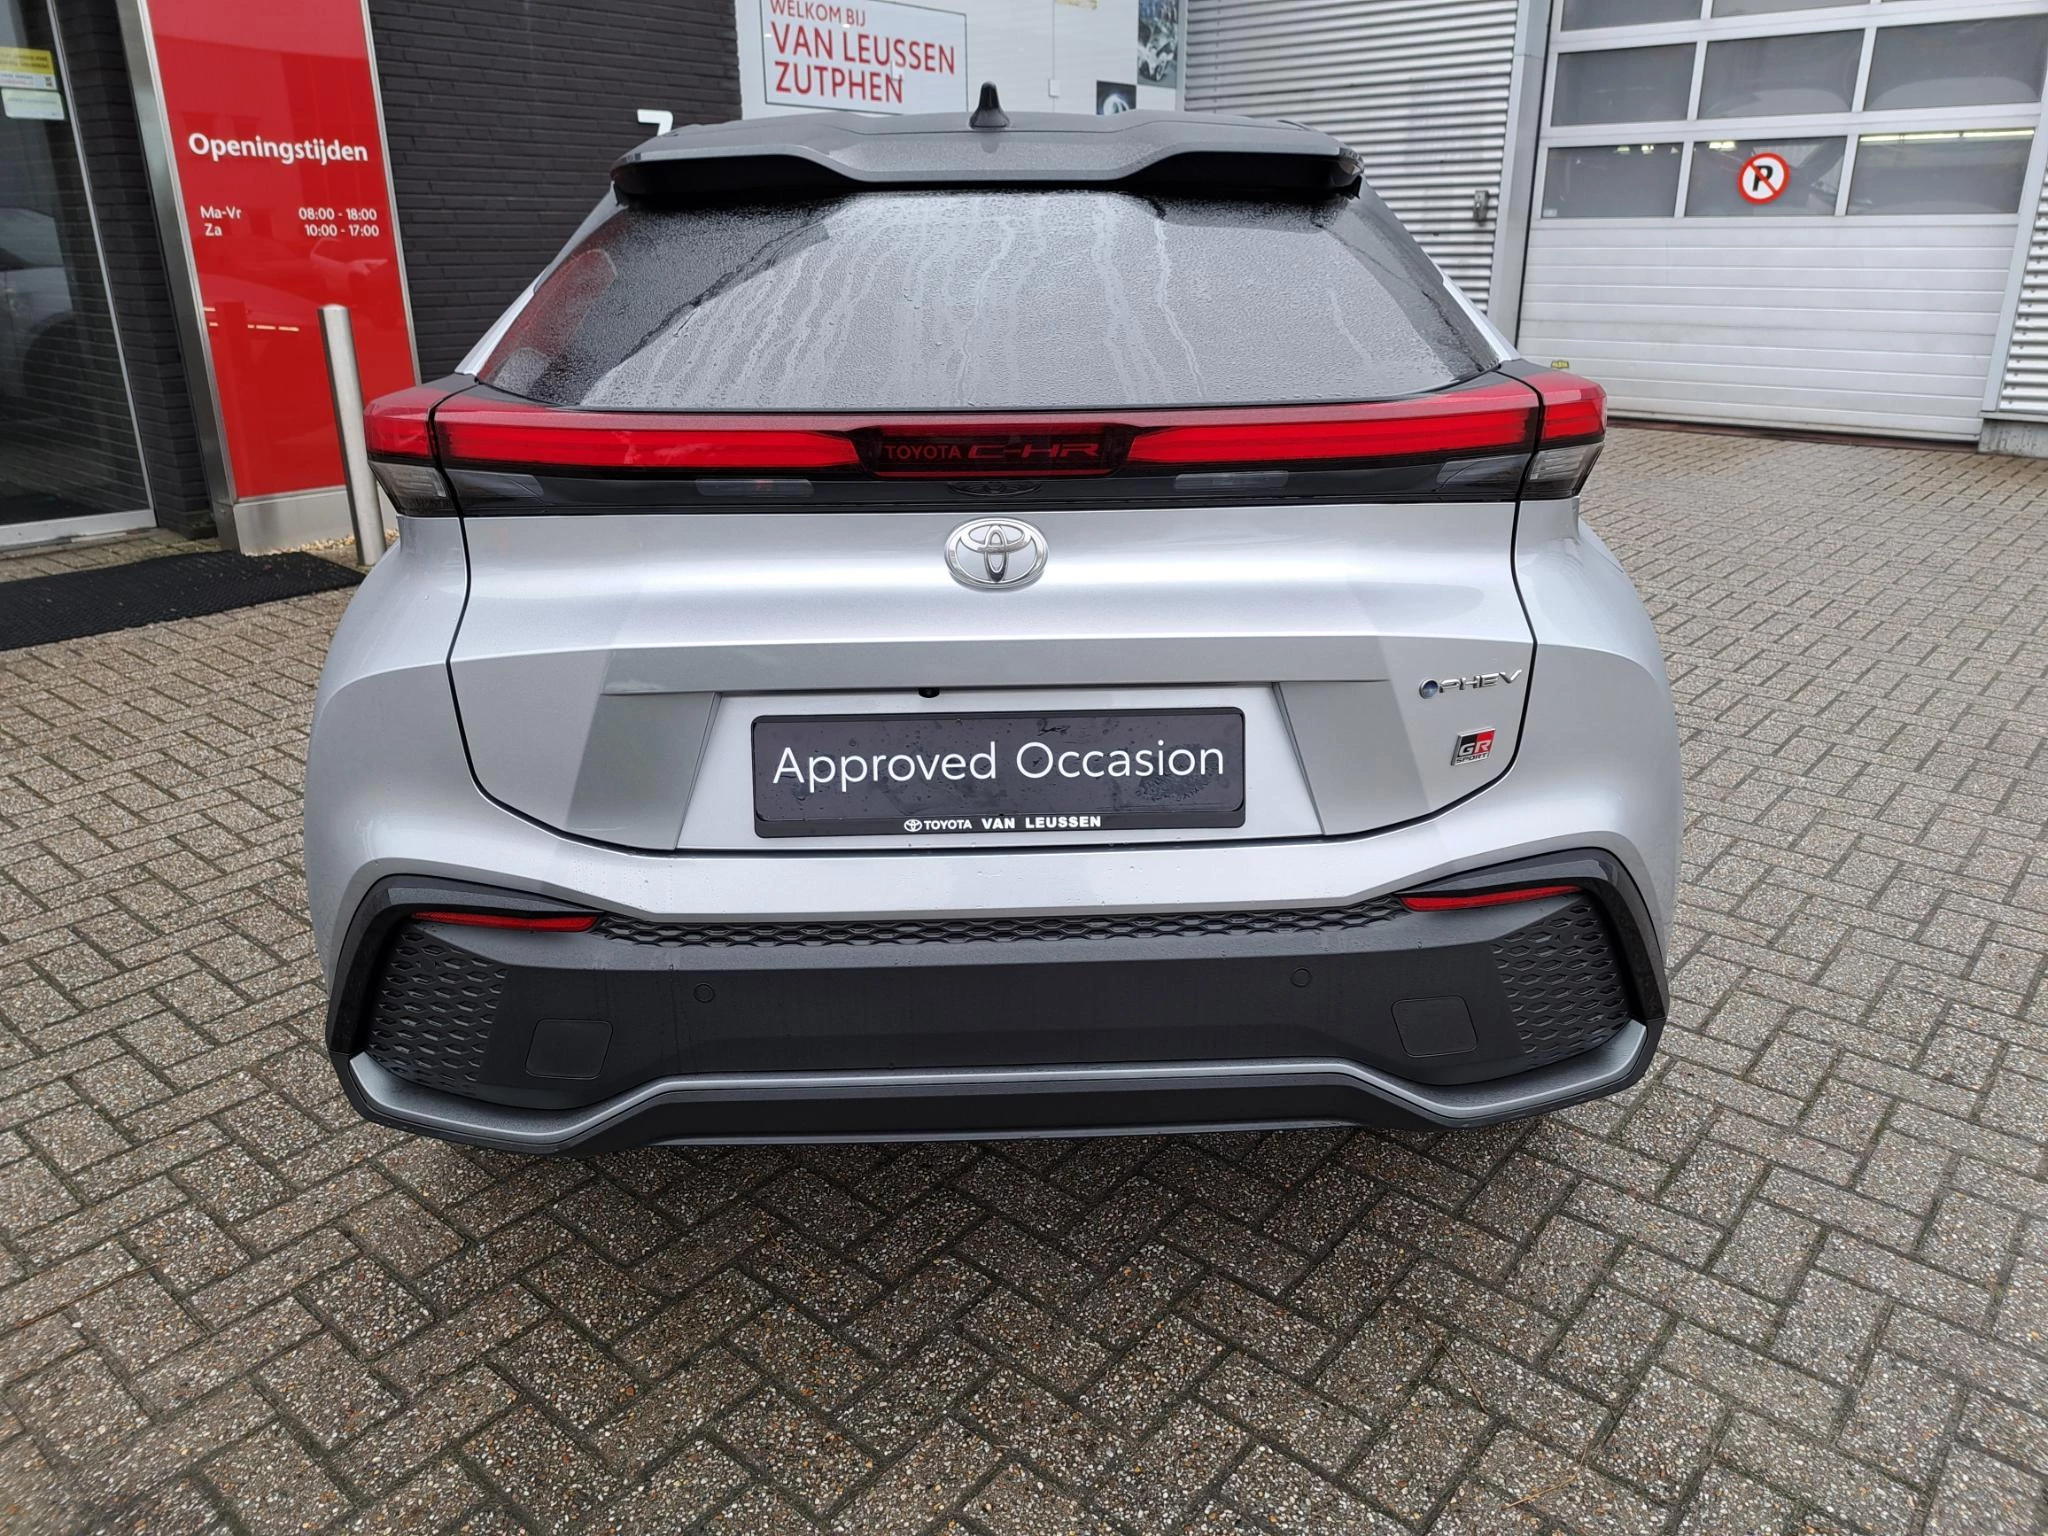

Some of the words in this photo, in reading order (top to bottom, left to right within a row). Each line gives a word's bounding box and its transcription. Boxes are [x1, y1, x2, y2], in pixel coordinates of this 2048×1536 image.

[770, 0, 841, 23] WELKOM
[846, 8, 866, 27] BIJ
[770, 21, 833, 60] VAN
[843, 31, 956, 75] LEUSSEN
[774, 60, 904, 104] ZUTPHEN
[188, 132, 368, 165] Openingstijden
[1752, 165, 1773, 192] P
[200, 205, 242, 220] Ma-Vr
[298, 207, 335, 221] 08:00
[346, 207, 377, 221] 18:00
[204, 223, 223, 237] Za
[305, 224, 337, 237] 10:00
[349, 224, 380, 237] 17:00
[885, 445, 961, 460] TOYOTA
[1439, 669, 1522, 693] PHEV
[1459, 740, 1491, 756] GR
[1456, 752, 1488, 763] SPORT
[773, 741, 997, 793] Approved
[1016, 739, 1224, 779] Occasion
[924, 819, 973, 830] TOYOTA
[981, 818, 1016, 829] VAN
[1024, 815, 1102, 829] LEUSSEN
